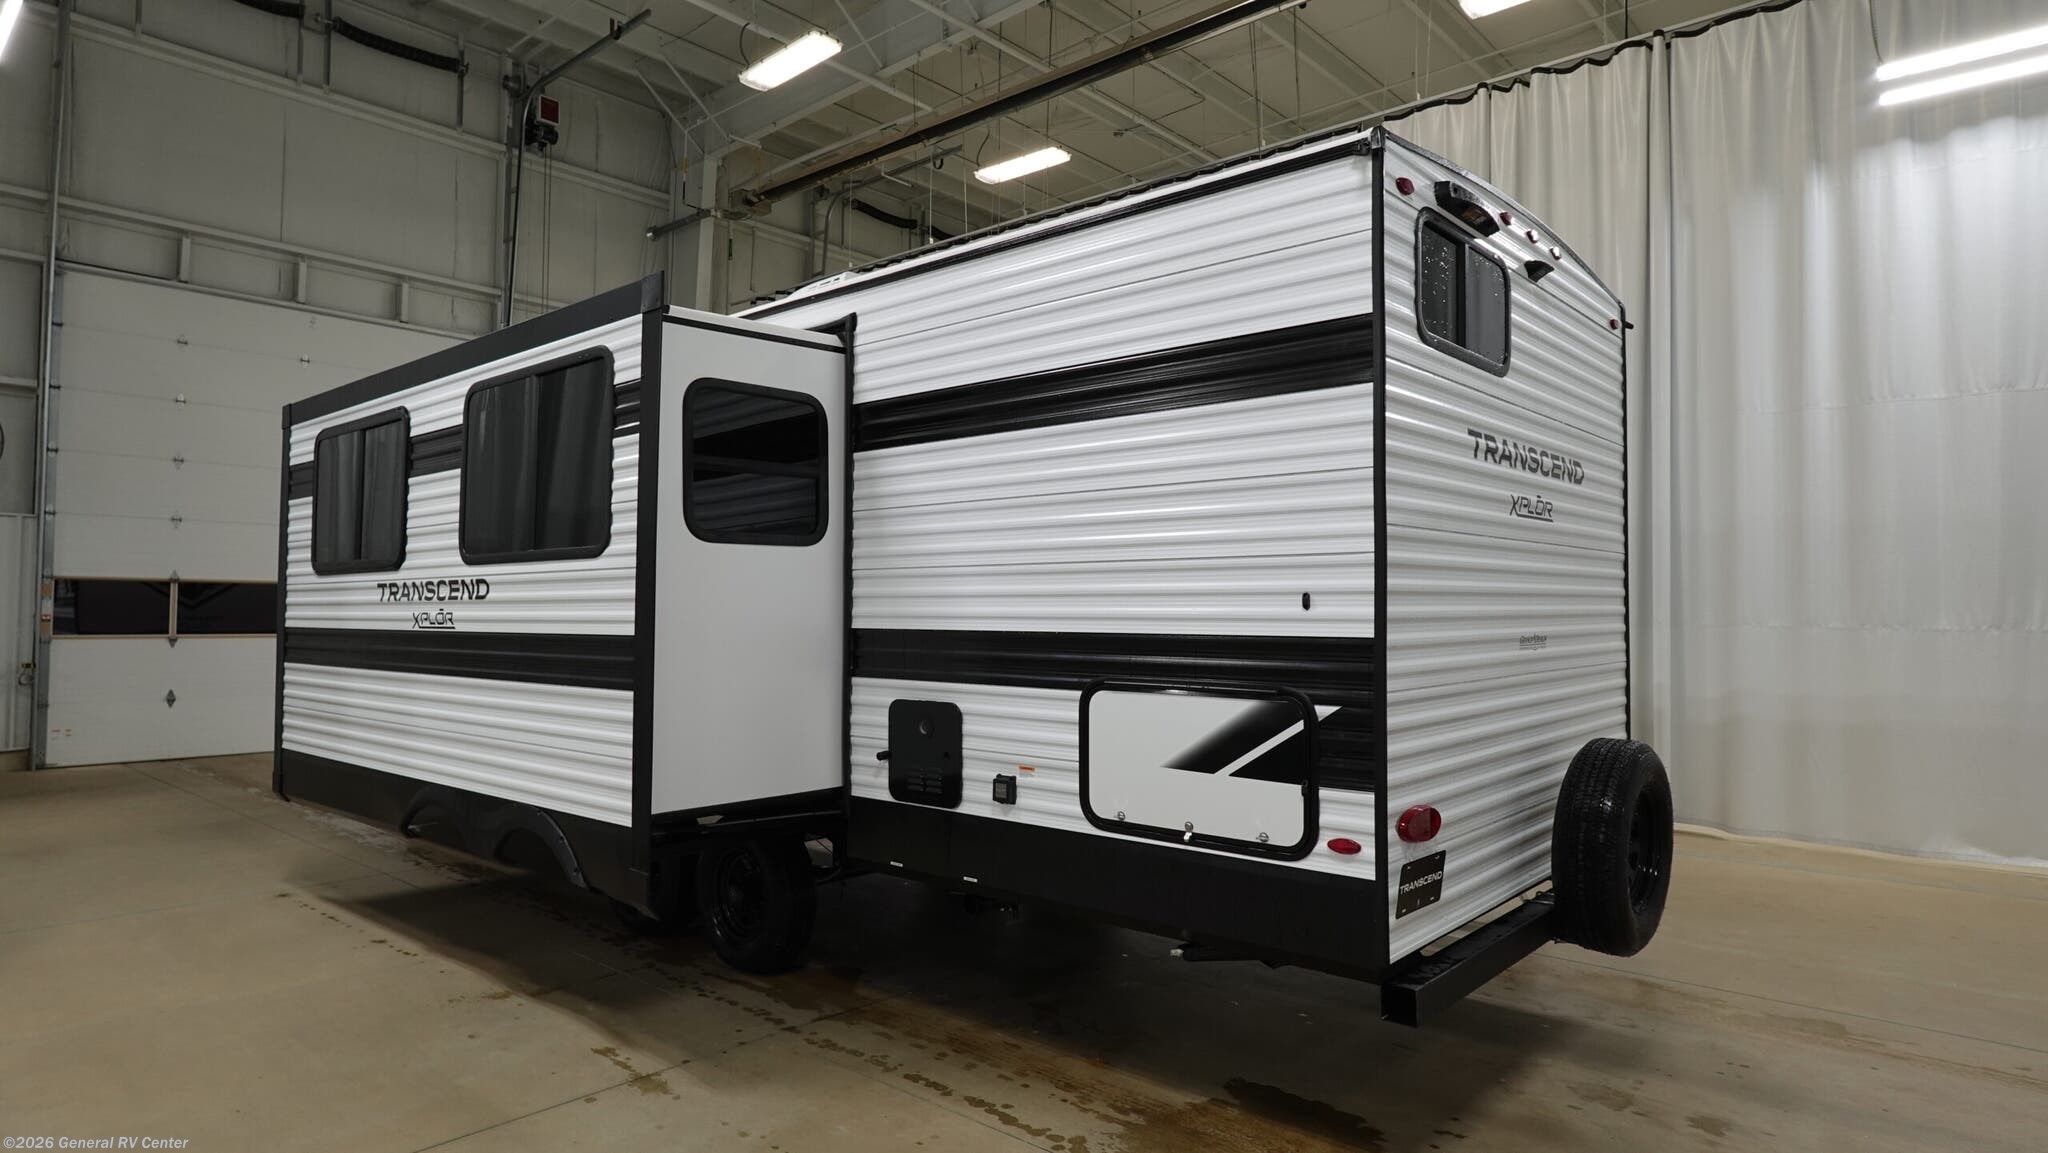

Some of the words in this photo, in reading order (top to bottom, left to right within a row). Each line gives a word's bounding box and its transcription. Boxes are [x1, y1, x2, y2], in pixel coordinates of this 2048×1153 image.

[1467, 427, 1585, 485] TRANSCEND
[377, 578, 490, 602] TRANSCEND
[1400, 870, 1443, 895] TRANSCEND
